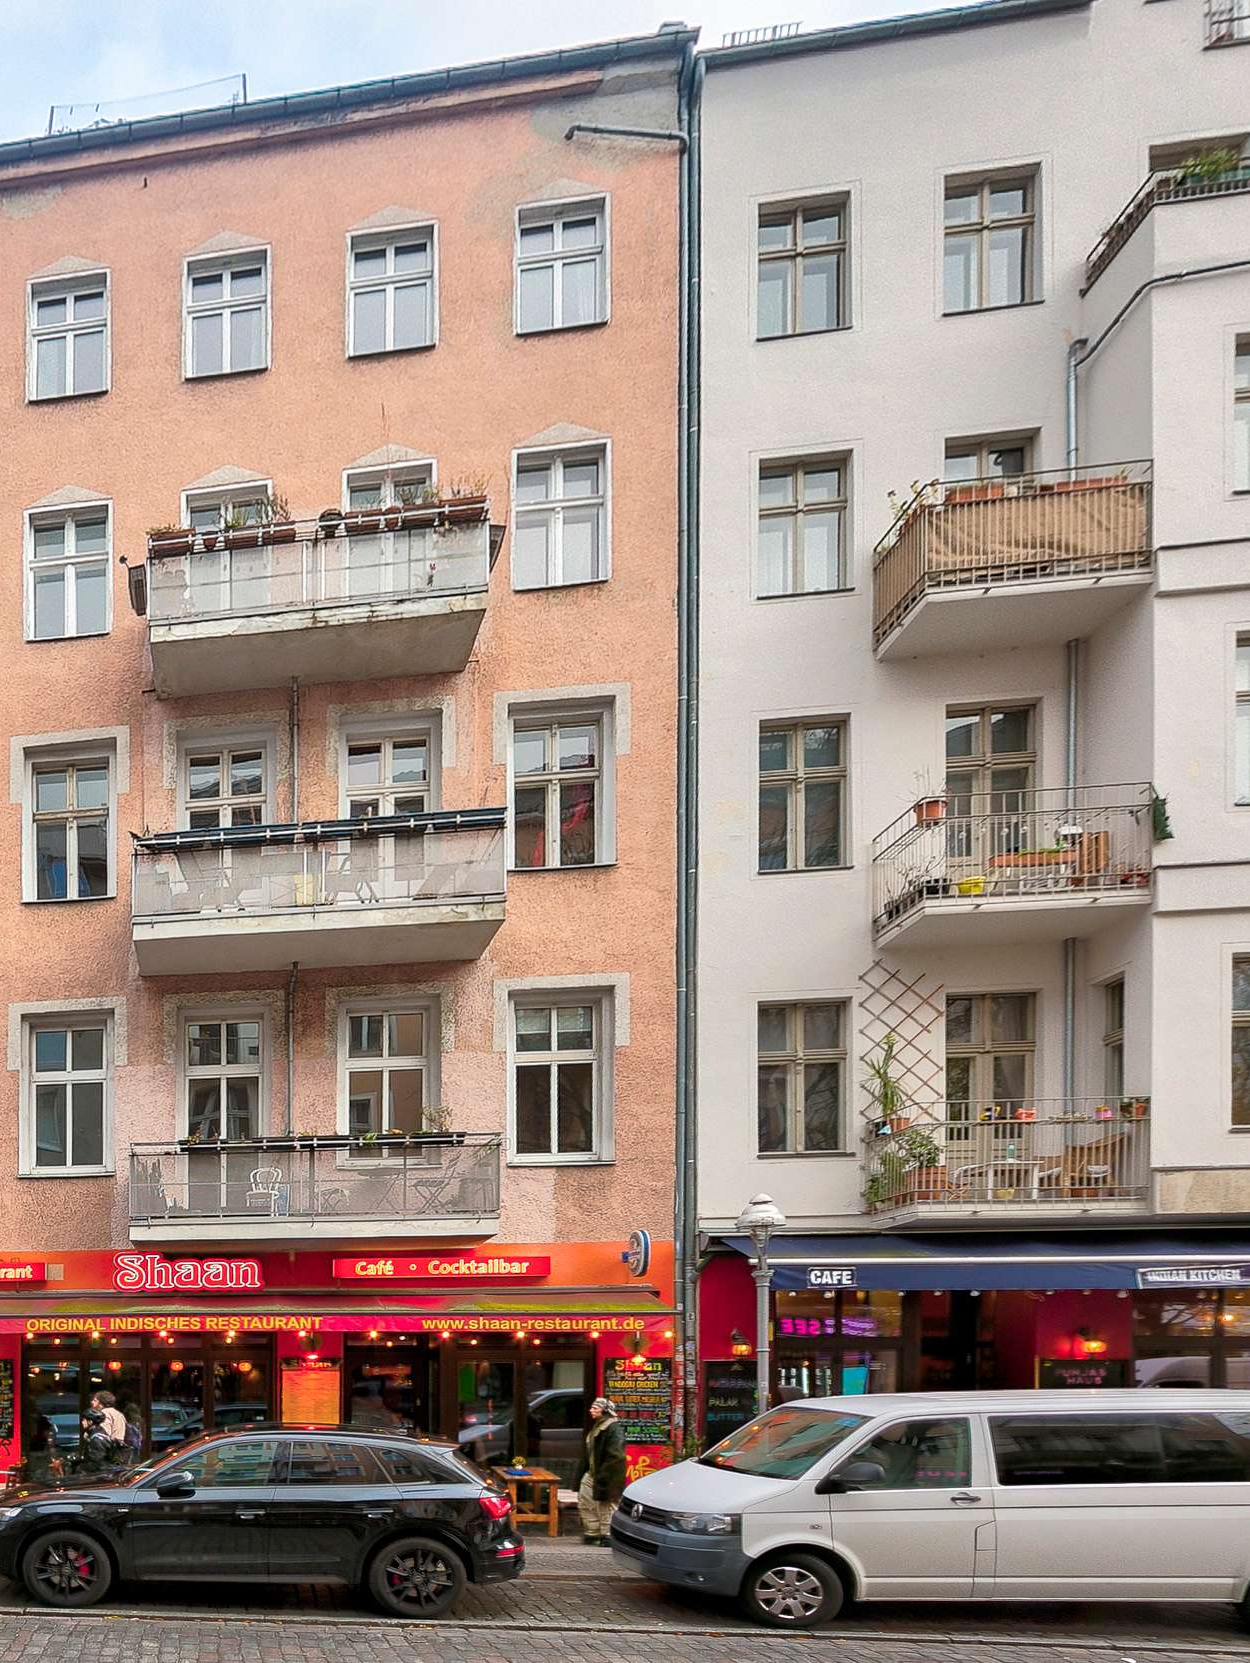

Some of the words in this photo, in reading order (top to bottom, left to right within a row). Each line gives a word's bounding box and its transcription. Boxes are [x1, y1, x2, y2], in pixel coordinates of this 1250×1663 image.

[116, 1253, 261, 1289] Shaan
[354, 1261, 395, 1276] Café
[427, 1258, 530, 1275] Cocktailbar
[810, 1270, 853, 1285] CAFE
[1147, 1269, 1187, 1282] INDIAN
[1189, 1268, 1241, 1281] KITCHEN
[26, 1318, 106, 1332] ORIGINAL
[110, 1317, 201, 1331] INDISCHES
[205, 1316, 323, 1330] RESTAURANT
[421, 1316, 645, 1331] www.shaan-restaurant.de
